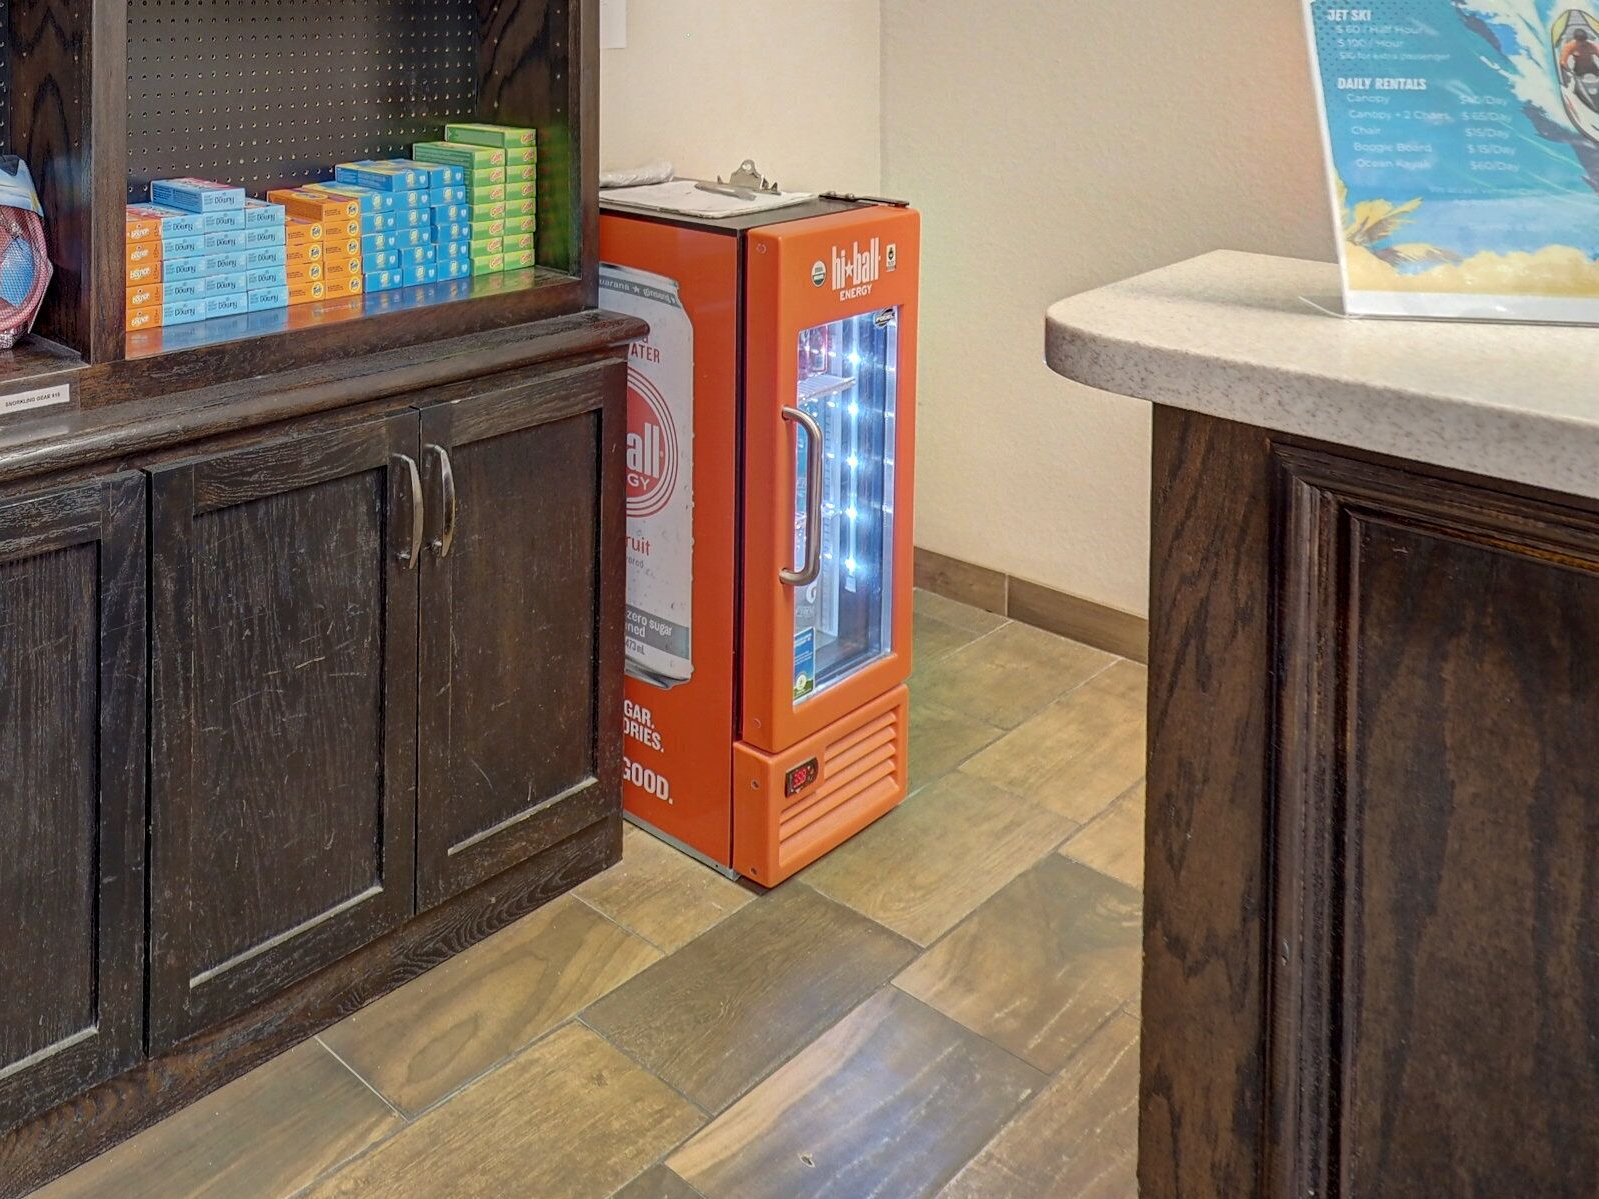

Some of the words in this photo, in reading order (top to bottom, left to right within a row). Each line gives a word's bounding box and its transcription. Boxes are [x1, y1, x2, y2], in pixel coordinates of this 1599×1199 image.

[1327, 9, 1348, 21] JET
[1351, 9, 1371, 21] SKI
[1375, 38, 1404, 48] Hour
[1356, 52, 1370, 60] for
[1372, 52, 1398, 60] extra
[1400, 52, 1450, 63] passenger
[1337, 77, 1371, 90] DAILY
[1375, 77, 1427, 90] RENTALS
[1346, 94, 1391, 105] Canopy
[1349, 110, 1392, 121] Canopy
[1351, 126, 1381, 135] Chair
[1353, 142, 1393, 153] Boogie
[1396, 143, 1433, 152] Board
[1354, 158, 1393, 168] Ocean
[839, 284, 873, 302] ENERGY
[630, 343, 661, 363] ATER
[37, 392, 51, 402] GEAR
[627, 610, 648, 626] zero
[649, 619, 673, 637] sugar
